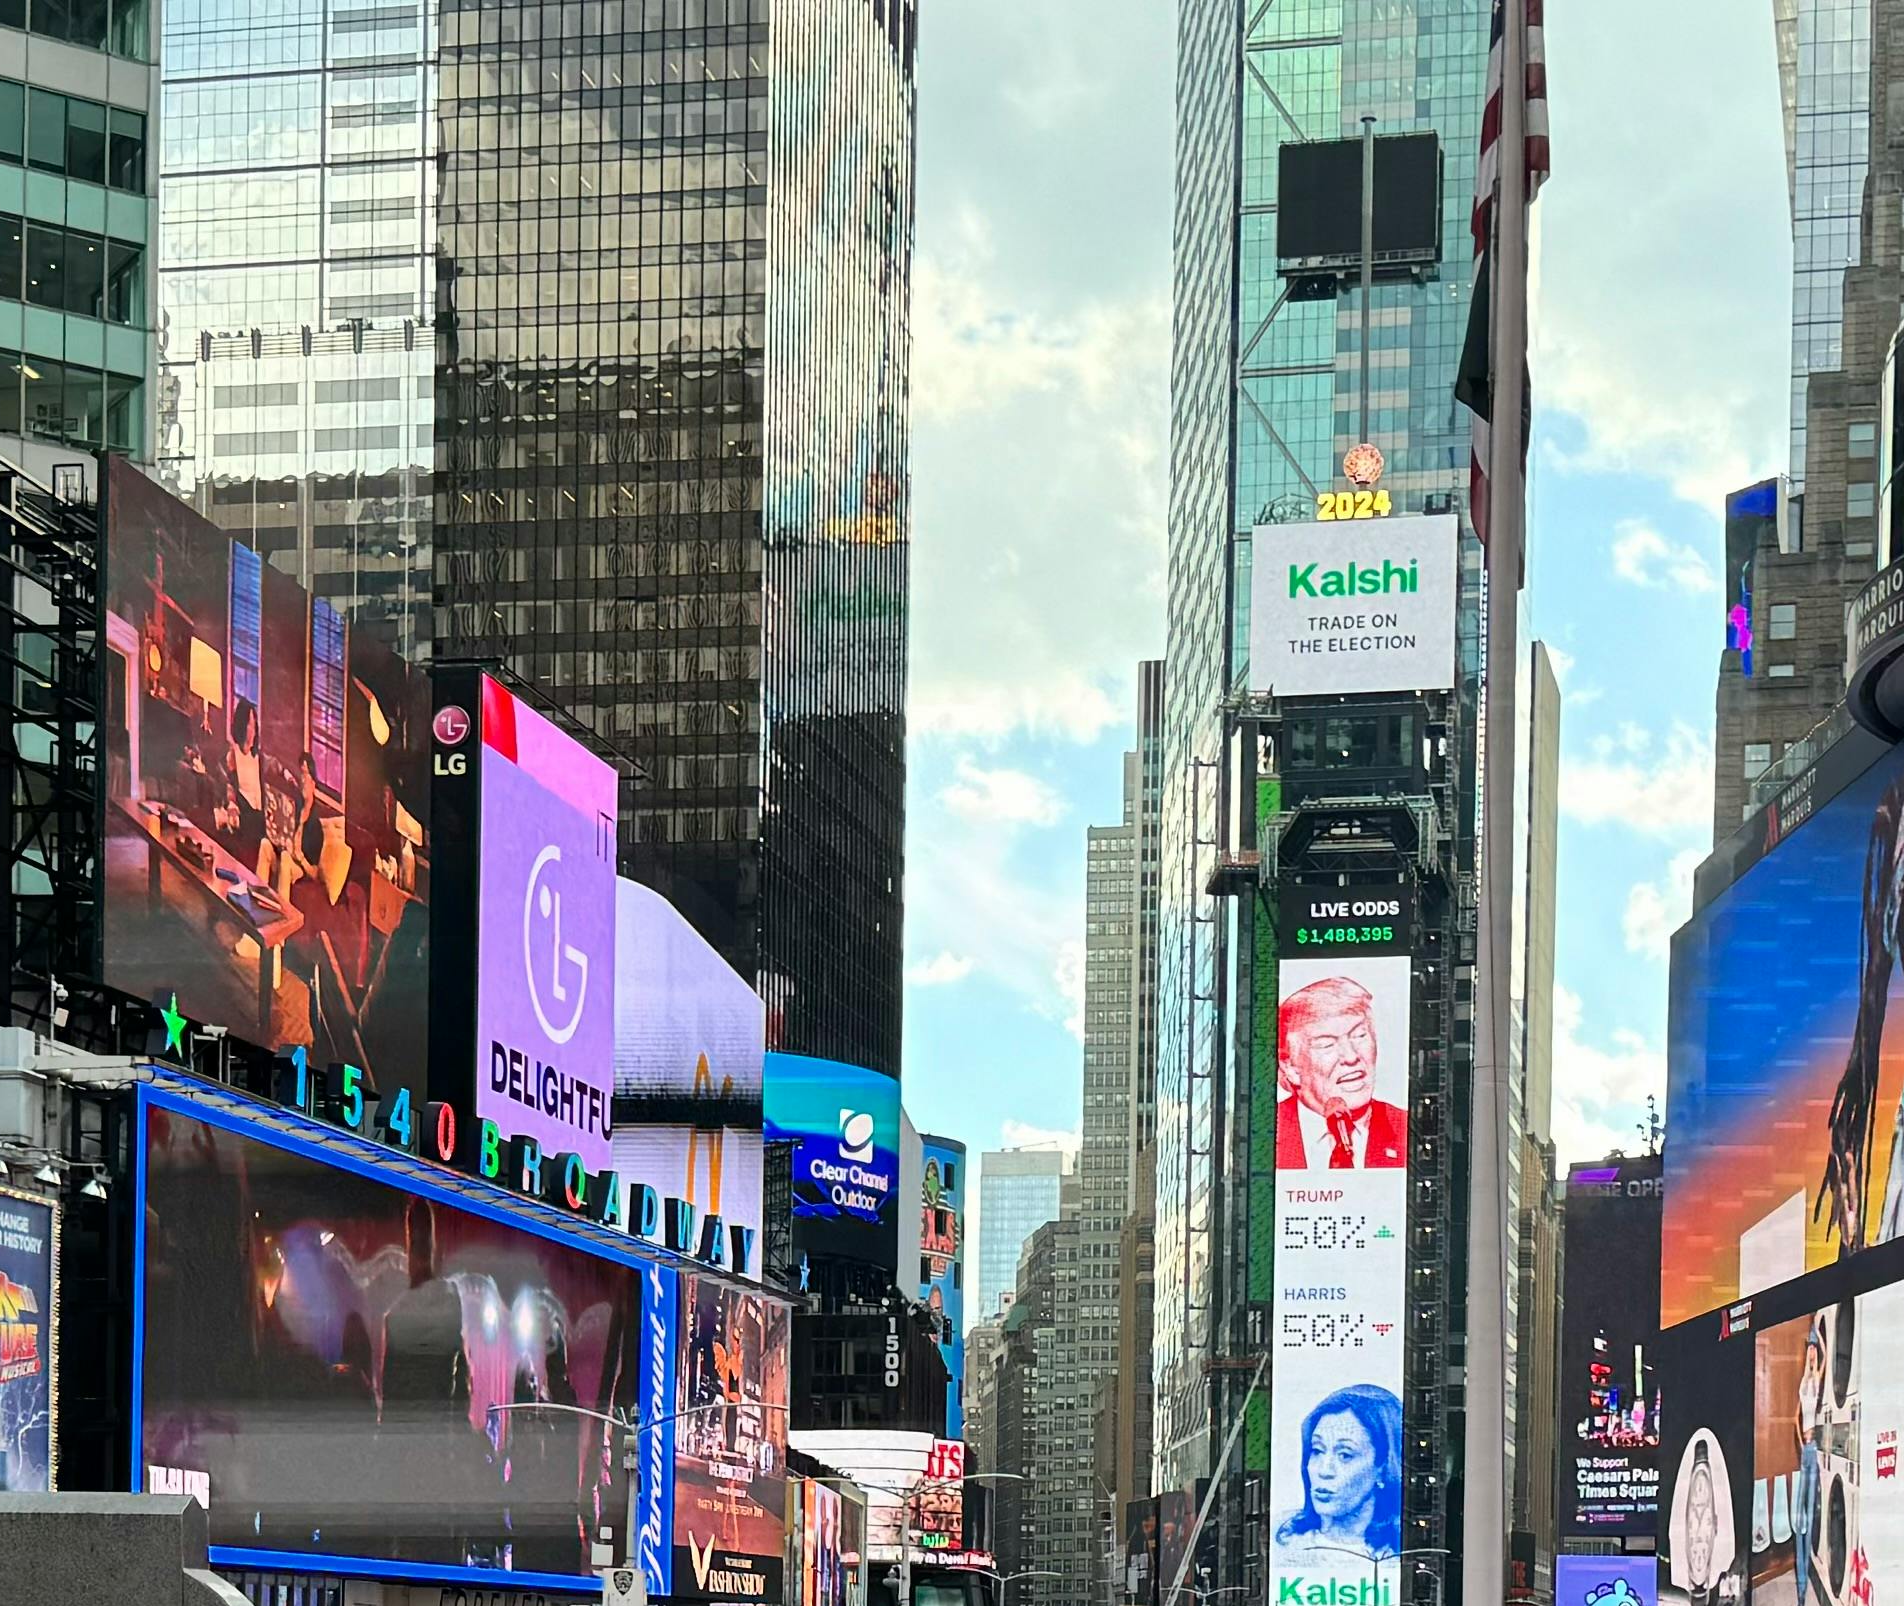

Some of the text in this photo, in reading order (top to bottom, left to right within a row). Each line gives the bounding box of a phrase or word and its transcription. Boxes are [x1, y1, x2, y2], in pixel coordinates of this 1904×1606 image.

[1317, 490, 1392, 520] 2024
[1288, 558, 1418, 599] Kalshi
[1307, 613, 1397, 631] TRADE ON
[1288, 635, 1417, 655] THE ELECTION
[434, 754, 467, 776] LG
[1310, 901, 1400, 919] LIVE ODDS
[810, 1159, 848, 1182] Clear
[831, 1185, 877, 1211] Outdoor
[1286, 1190, 1344, 1203] TRUMP
[1284, 1216, 1366, 1250] 50%
[1284, 1287, 1347, 1301] HARRIS
[1283, 1314, 1365, 1348] 50%
[1577, 1469, 1630, 1483] Caesars
[1577, 1484, 1617, 1498] Times
[1279, 1576, 1390, 1606] Kalshi
